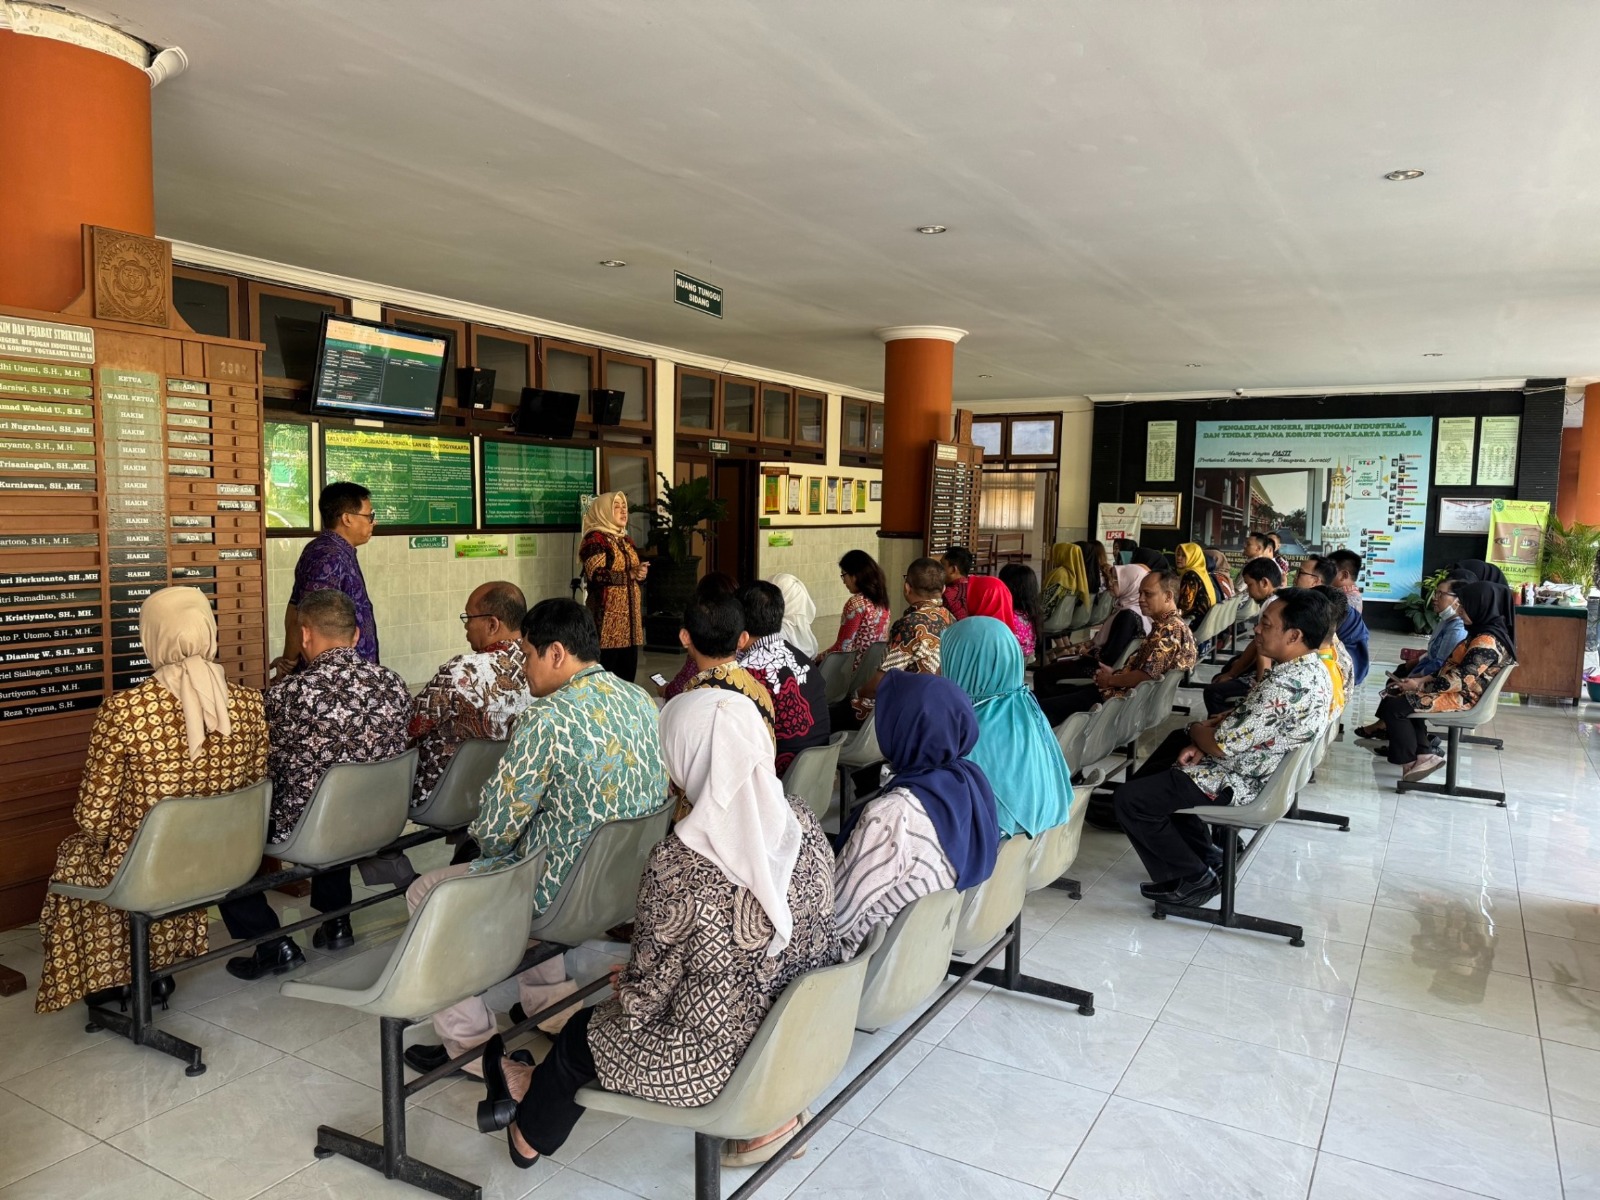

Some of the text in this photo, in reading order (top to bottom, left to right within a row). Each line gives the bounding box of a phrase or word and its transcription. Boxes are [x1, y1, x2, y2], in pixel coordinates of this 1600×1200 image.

[677, 278, 721, 302] RUANG TUNGGU
[689, 294, 710, 308] SIDANG
[12, 323, 25, 336] DAN
[27, 325, 52, 339] PEJABAT
[54, 328, 91, 343] STRUKTURAL
[22, 339, 50, 348] HUBUNGAN
[51, 343, 80, 351] INDUSTRIAL
[7, 345, 32, 353] KORUPSI
[34, 348, 70, 357] YOGYAKARTA
[71, 351, 86, 359] KELAS
[13, 365, 41, 374] Utami,
[43, 367, 62, 376] S.H.,
[64, 369, 83, 378] M.H.
[118, 375, 142, 383] KETUA
[31, 386, 51, 395] S.H.,
[53, 387, 72, 396] M.H.
[107, 393, 130, 401] WAKIL
[22, 404, 52, 414] Wachid
[67, 408, 84, 416] S.H.
[11, 422, 57, 433] Nugraheni,
[1270, 423, 1303, 431] NEGERI,
[1353, 422, 1407, 430] INDUSTRIAL
[34, 443, 55, 451] S.H.,
[56, 443, 75, 451] M.H.
[0, 461, 54, 470] Trisaningsih,
[0, 482, 47, 490] Kurniawan,
[15, 576, 67, 584] Herkutanto,
[13, 594, 59, 603] Ramadhan,
[5, 612, 57, 622] Kristiyanto,
[23, 632, 52, 640] Utomo,
[53, 629, 73, 637] S.H.,
[75, 627, 93, 635] M.H.
[6, 653, 40, 661] Dianing
[14, 668, 53, 678] Siallagan,
[75, 663, 94, 671] M.H.
[40, 686, 60, 694] S.H.,
[62, 683, 80, 691] M.H.
[3, 701, 76, 718] Reza Tyrama, S.H.
